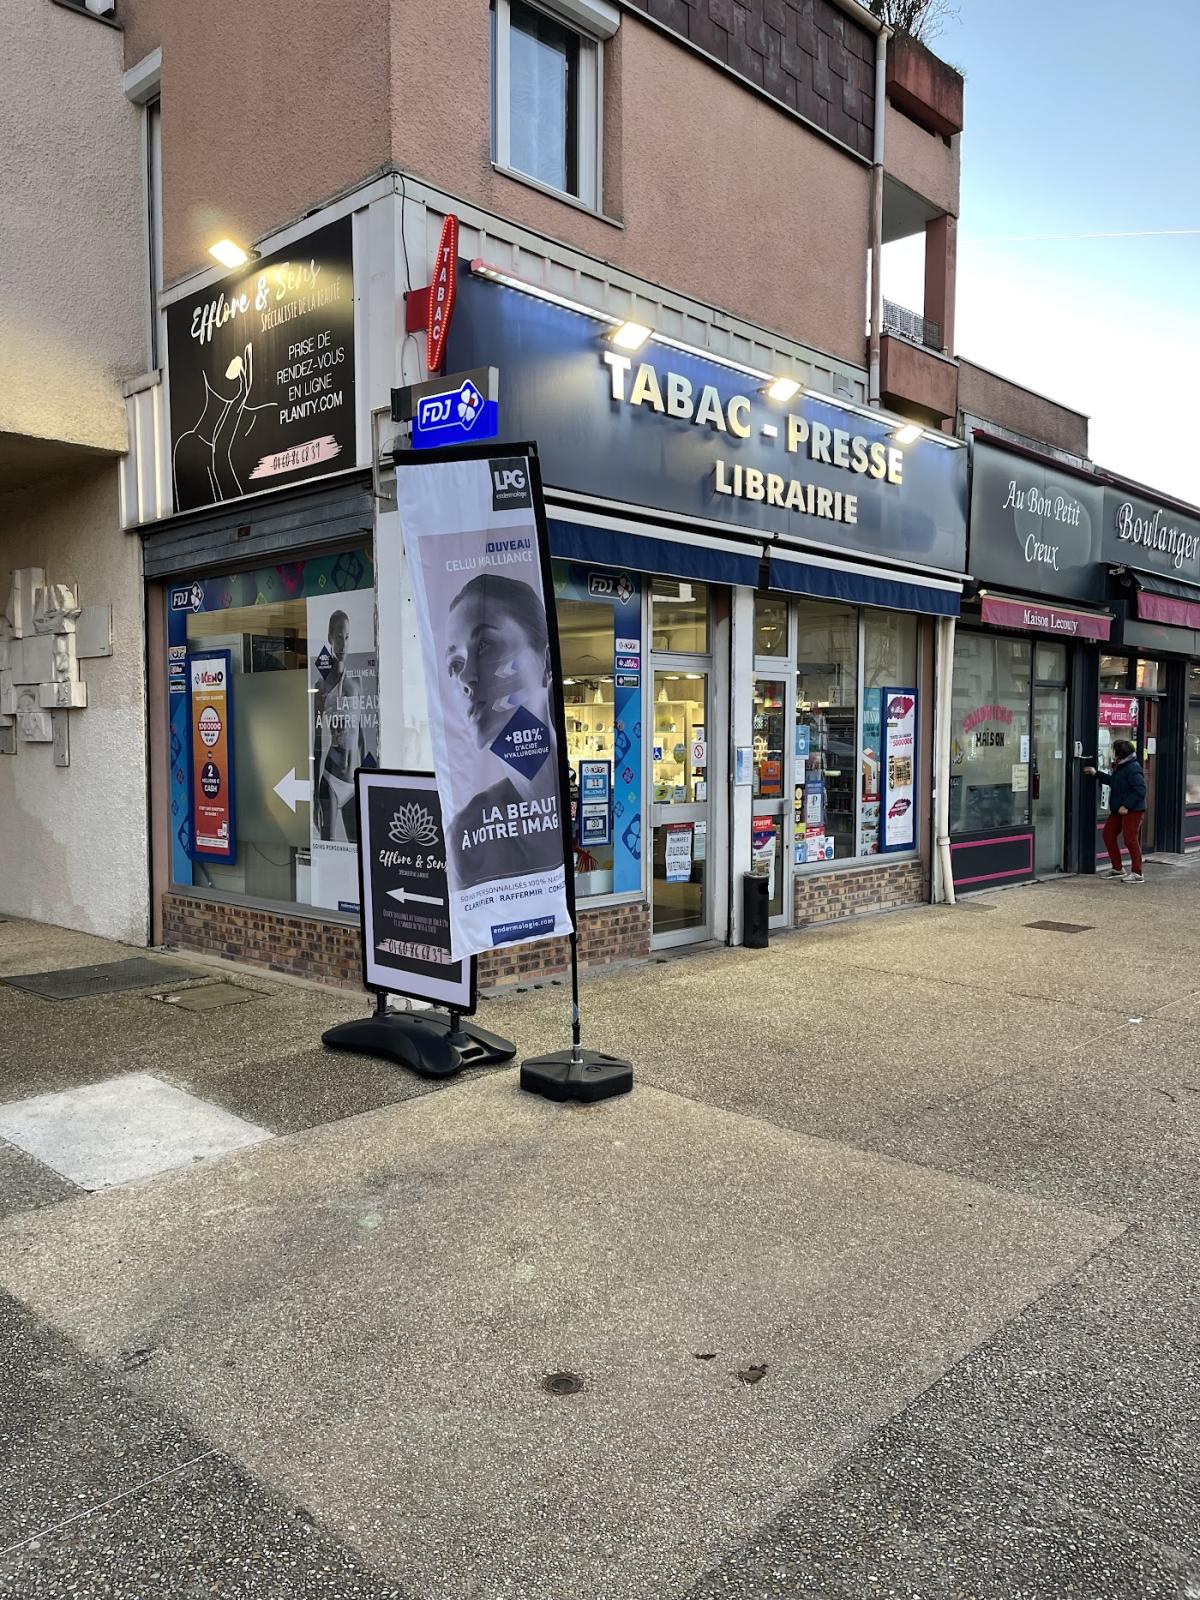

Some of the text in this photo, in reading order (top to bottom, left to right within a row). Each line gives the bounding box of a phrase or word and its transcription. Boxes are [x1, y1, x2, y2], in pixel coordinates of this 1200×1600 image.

[255, 274, 270, 311] &
[432, 247, 452, 341] TABAC
[288, 330, 331, 361] PRISE DE
[276, 346, 345, 386] RENDEZ-VOUS
[288, 372, 333, 402] EN LIGNE
[279, 390, 343, 425] PLANITY.COM
[421, 400, 452, 424] FDJ
[603, 351, 752, 438] TABAC
[787, 413, 904, 485] PRESSE
[493, 469, 526, 491] LPG
[714, 460, 859, 524] LIBRAIRIE
[1002, 480, 1081, 526] Au Bon Petit
[1025, 533, 1060, 571] Creux
[446, 558, 477, 573] CELLU
[591, 578, 614, 594] FDJ
[173, 592, 189, 607] FDJ
[1023, 609, 1049, 628] Maison
[336, 696, 350, 711] LA
[315, 710, 323, 729] À
[325, 713, 358, 729] VOTRE
[482, 806, 504, 825] LA
[461, 829, 472, 851] À
[472, 821, 519, 846] VOTRE
[415, 854, 424, 869] &
[464, 896, 495, 912] CLARIFIER
[500, 888, 543, 902] RAFFERMIR
[493, 919, 554, 934] endermologie.com
